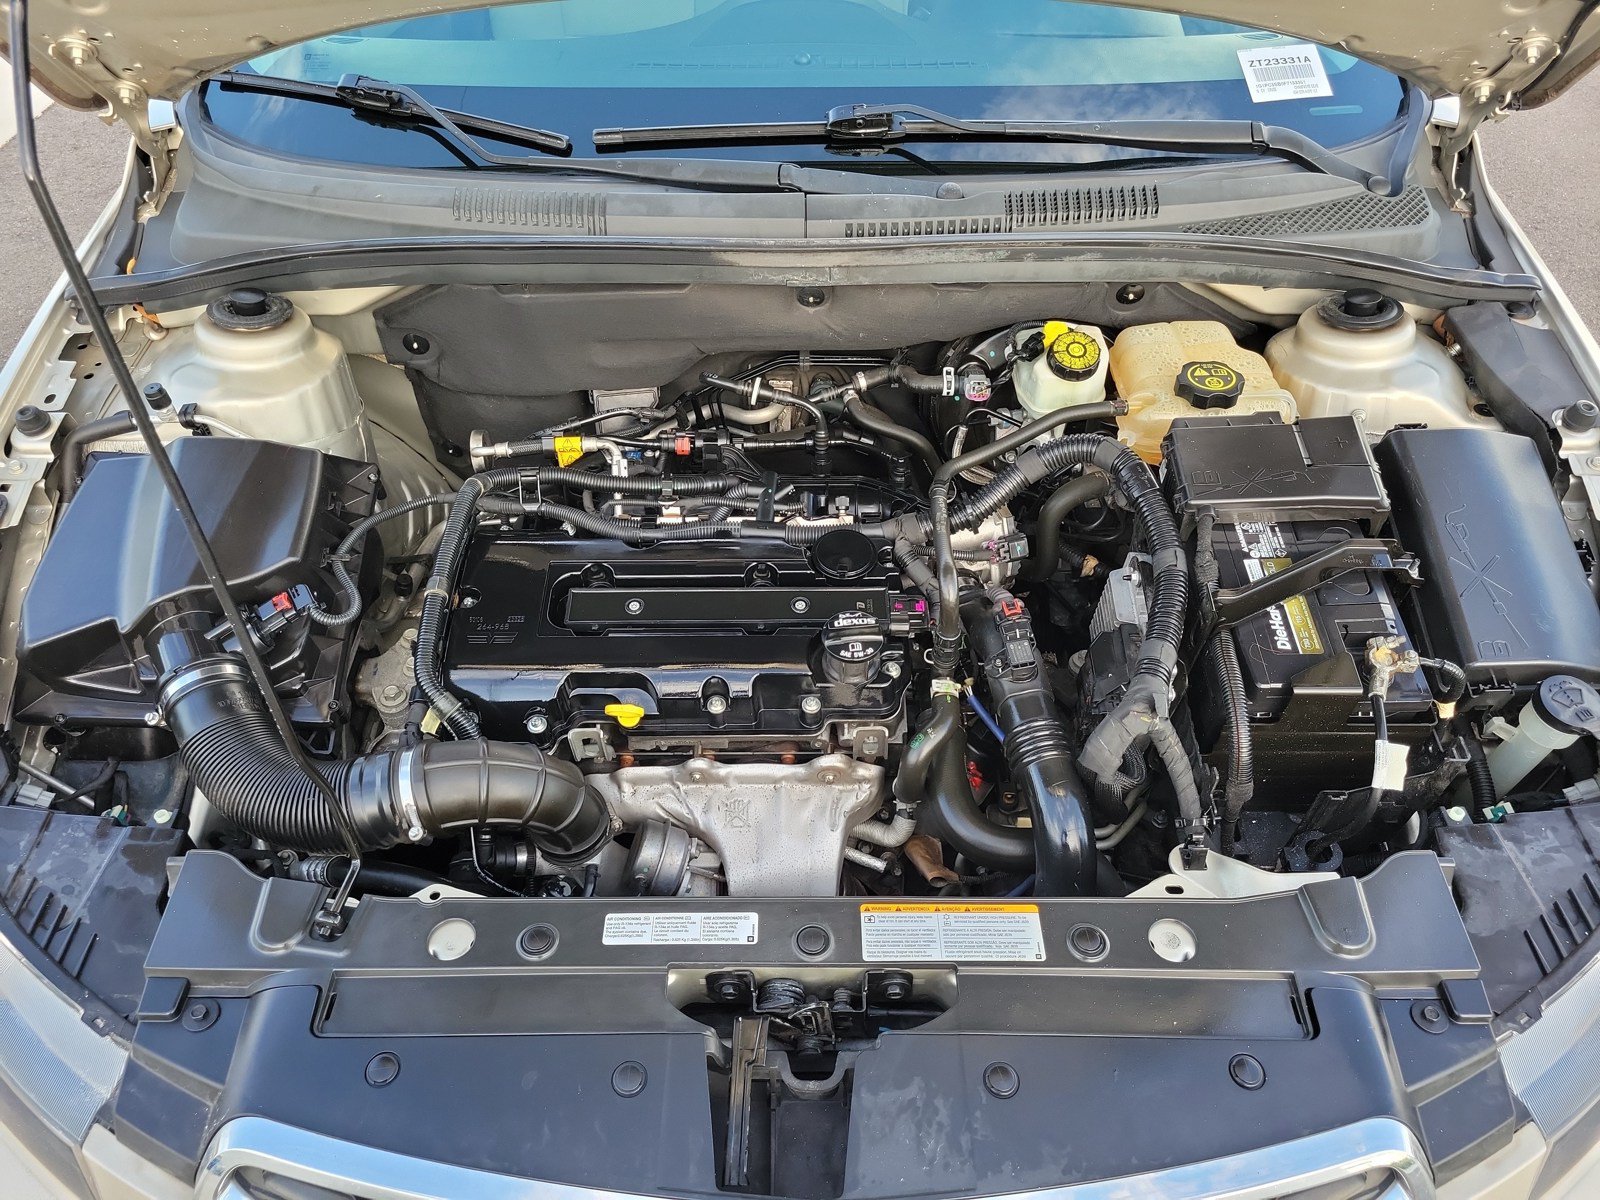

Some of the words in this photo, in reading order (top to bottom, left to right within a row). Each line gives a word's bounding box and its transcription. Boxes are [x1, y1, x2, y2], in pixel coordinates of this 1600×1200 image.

[1248, 56, 1312, 68] ZT23331A
[834, 618, 876, 627] dexos
[1266, 604, 1292, 650] DieHar
[854, 648, 874, 658] 5W-30
